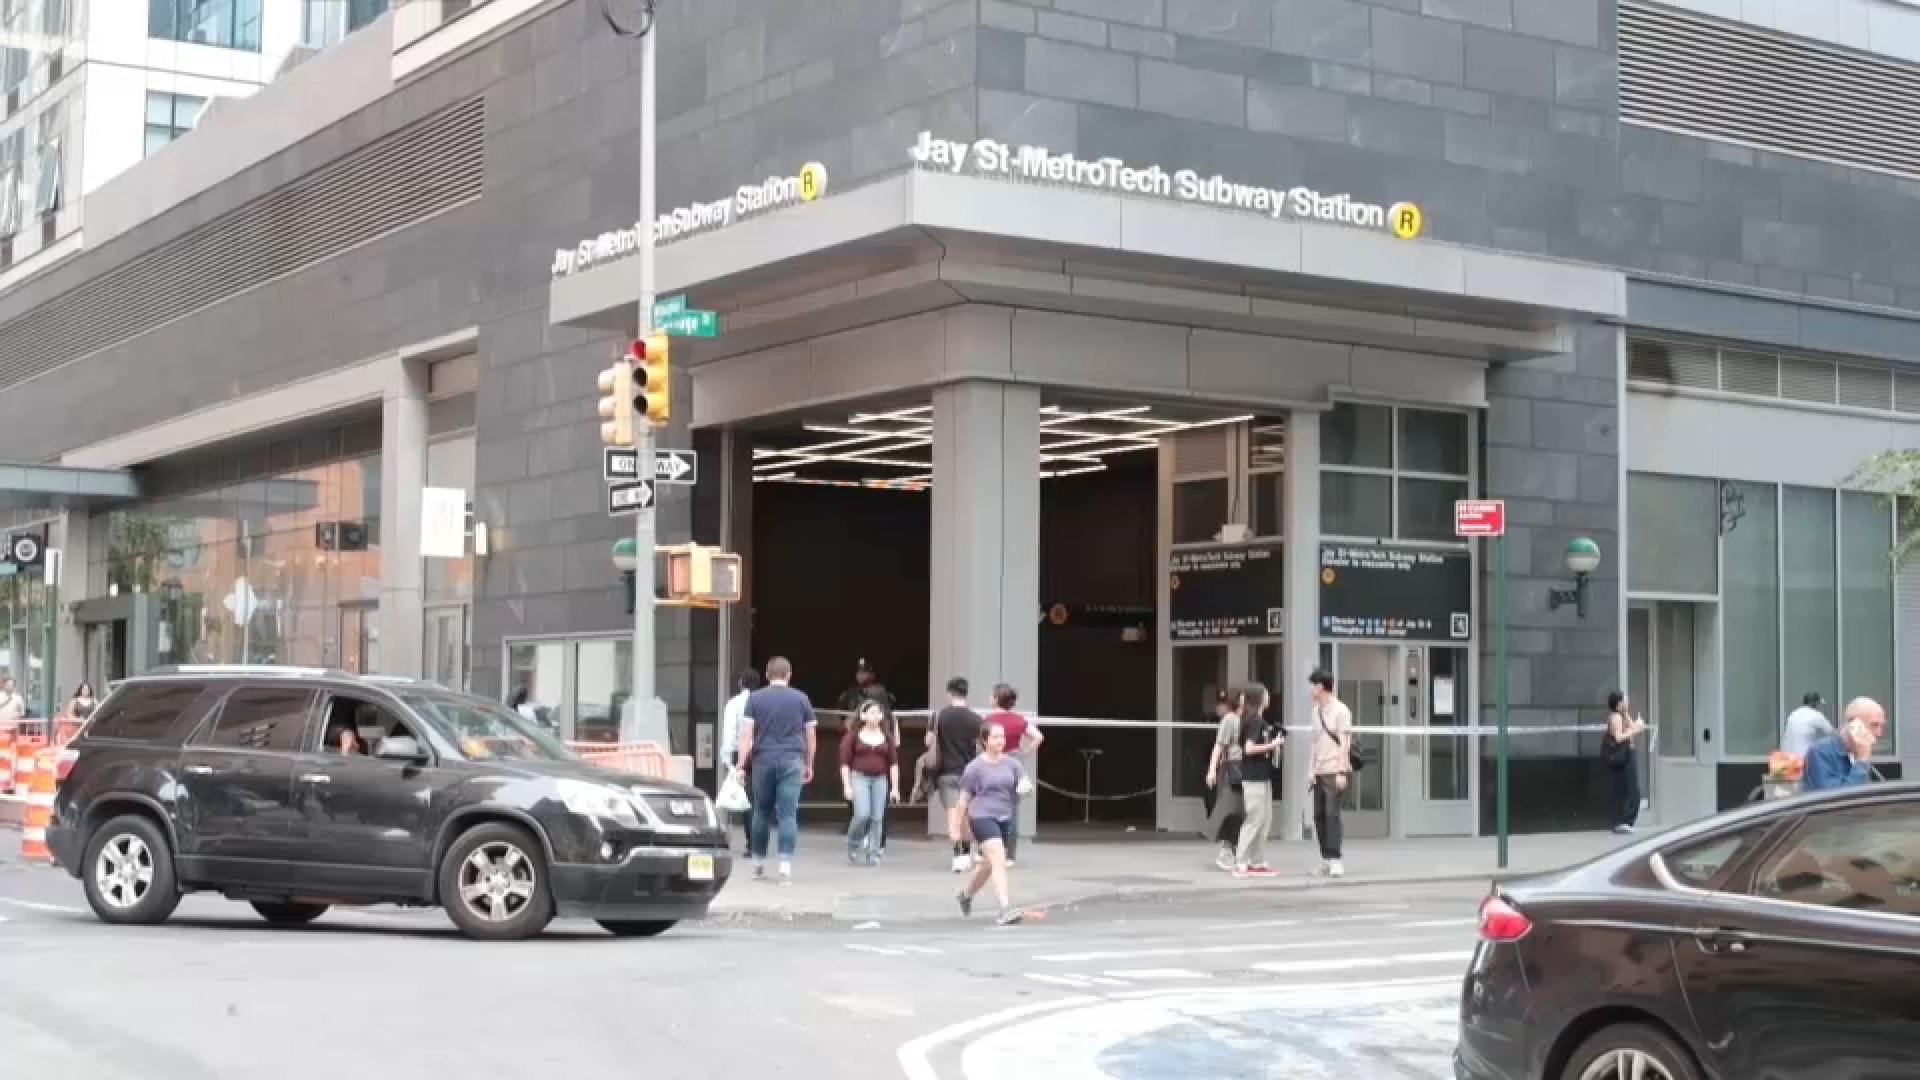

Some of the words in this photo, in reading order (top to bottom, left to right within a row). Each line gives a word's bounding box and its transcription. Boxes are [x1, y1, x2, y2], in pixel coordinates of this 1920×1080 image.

[551, 248, 577, 275] Jay
[673, 198, 733, 234] Subway
[736, 175, 796, 215] Station
[909, 131, 967, 173] Jay
[975, 138, 1170, 197] St-MetroTech
[1175, 169, 1285, 218] Subway
[1288, 186, 1385, 229] Station
